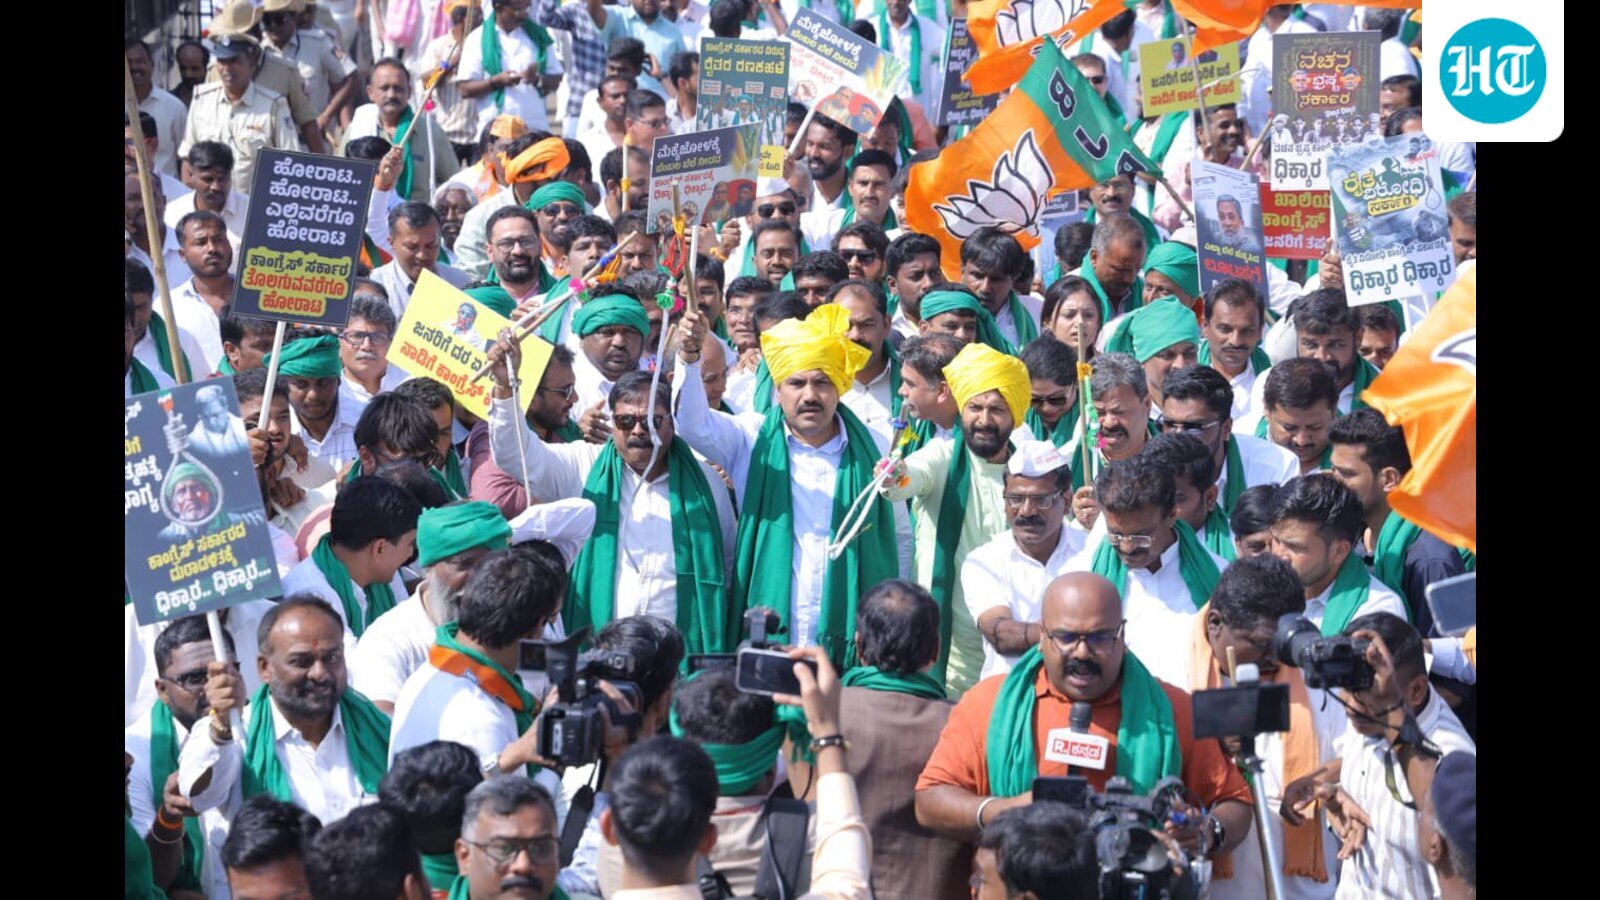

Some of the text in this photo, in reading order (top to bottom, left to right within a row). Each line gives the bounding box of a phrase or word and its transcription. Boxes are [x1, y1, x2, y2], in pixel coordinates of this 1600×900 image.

[705, 41, 733, 55] ಕಾಂಗ್ರೆಸ್
[1299, 50, 1352, 73] ವಚನ
[704, 56, 732, 77] ರೈತರ
[735, 59, 785, 74] ರಣಕಹಳೆ
[1312, 72, 1340, 92] ಭ್ರಷ್ಟ
[657, 136, 721, 161] ಮೆಕ್ಕೆಜೋಳಕ್ಕೆ
[273, 157, 361, 185] ಹೋರಾಟ..
[1275, 158, 1321, 188] ಧಿಕ್ಕಾರ
[1342, 170, 1376, 198] ರೈತ
[269, 178, 358, 206] ಹೋರಾಟ..
[1363, 177, 1425, 200] ವಿರೋಧಿ
[265, 201, 354, 227] ಎಲ್ಲಿವರೆಗೂ
[1262, 210, 1326, 233] ಕಾಂಗ್ರೆಸ್
[267, 219, 347, 245] ಹೋರಾಟ
[250, 253, 350, 277] ಕಾಂಗ್ರೆಸ್ ಸರ್ಕಾರ
[1349, 254, 1452, 295] ಧಿಕ್ಕಾರ ಧಿಕ್ಕಾರ
[246, 267, 345, 296] ತೊಲಗುವವರೆಗೂ
[262, 291, 323, 313] ಹೋರಾಟ
[413, 321, 472, 366] ಜನರಿಗೆ ದರ
[400, 341, 438, 371] ನಾಡಿಗೆ
[435, 363, 484, 397] ಕಾಂಗ್ರೆಸ್
[148, 521, 246, 570] ಕಾಂಗ್ರೆಸ್ ಸರ್ಕಾರದ
[169, 545, 238, 582] ದುರಾಡಳಿತಕ್ಕೆ
[154, 558, 272, 616] ಧಿಕ್ಕಾರ.. ಧಿಕ್ಕಾರ...
